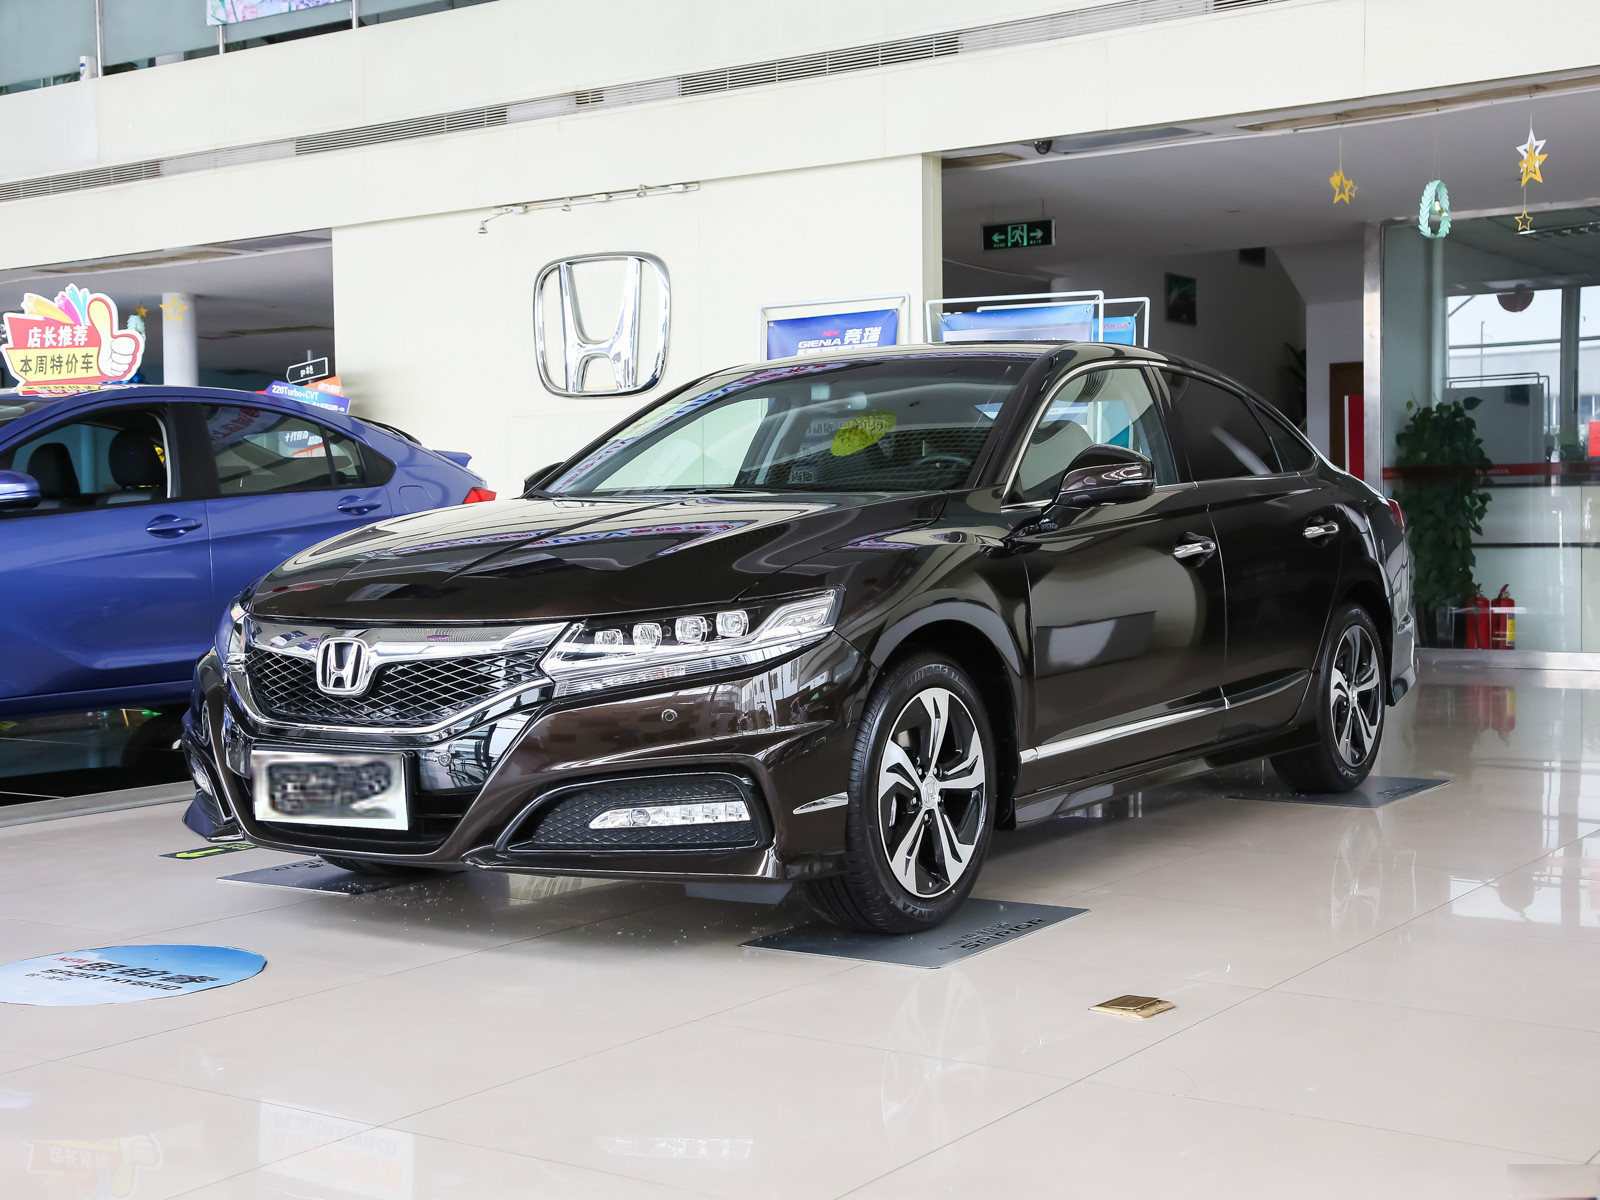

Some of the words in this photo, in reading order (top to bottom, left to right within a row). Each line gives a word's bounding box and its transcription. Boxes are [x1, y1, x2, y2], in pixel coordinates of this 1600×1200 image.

[27, 325, 88, 347] 店长推荐
[797, 337, 841, 349] GIENIA
[843, 326, 882, 344] 竞瑞
[20, 353, 94, 375] 本周特价车
[960, 918, 1046, 950] SPIRIOR
